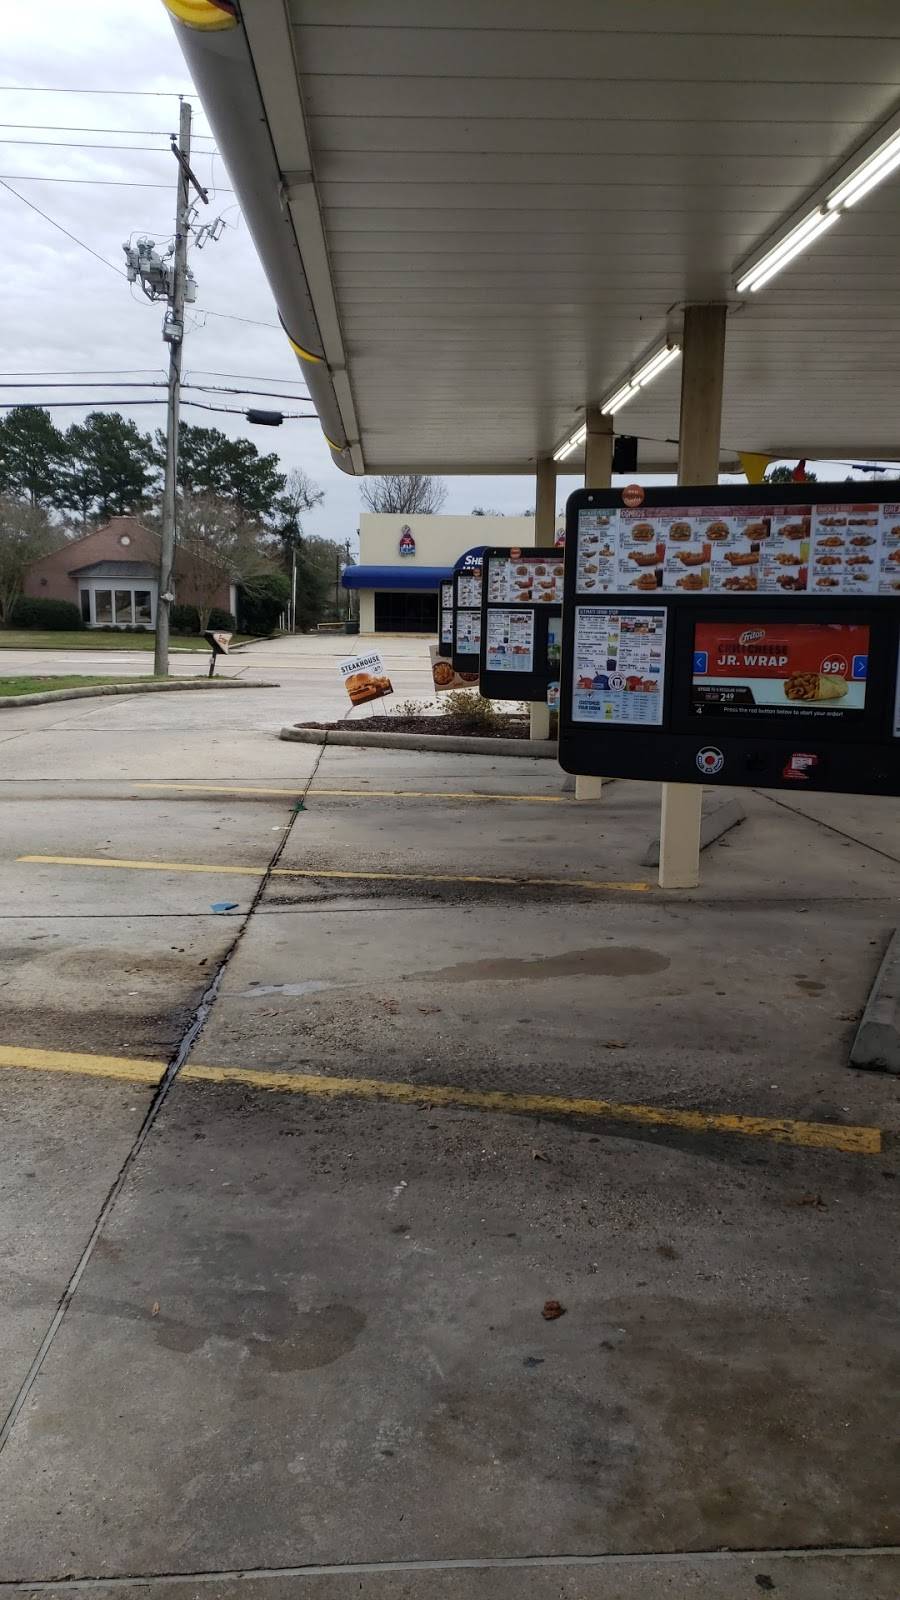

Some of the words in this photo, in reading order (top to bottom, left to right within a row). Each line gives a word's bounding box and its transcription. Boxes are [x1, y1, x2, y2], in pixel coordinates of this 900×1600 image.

[743, 630, 763, 642] Fritos
[748, 645, 788, 655] CHEESE
[340, 655, 381, 673] STEAKHOUSE
[717, 655, 740, 666] JR.
[744, 655, 789, 667] WRAP
[823, 661, 846, 673] 99¢
